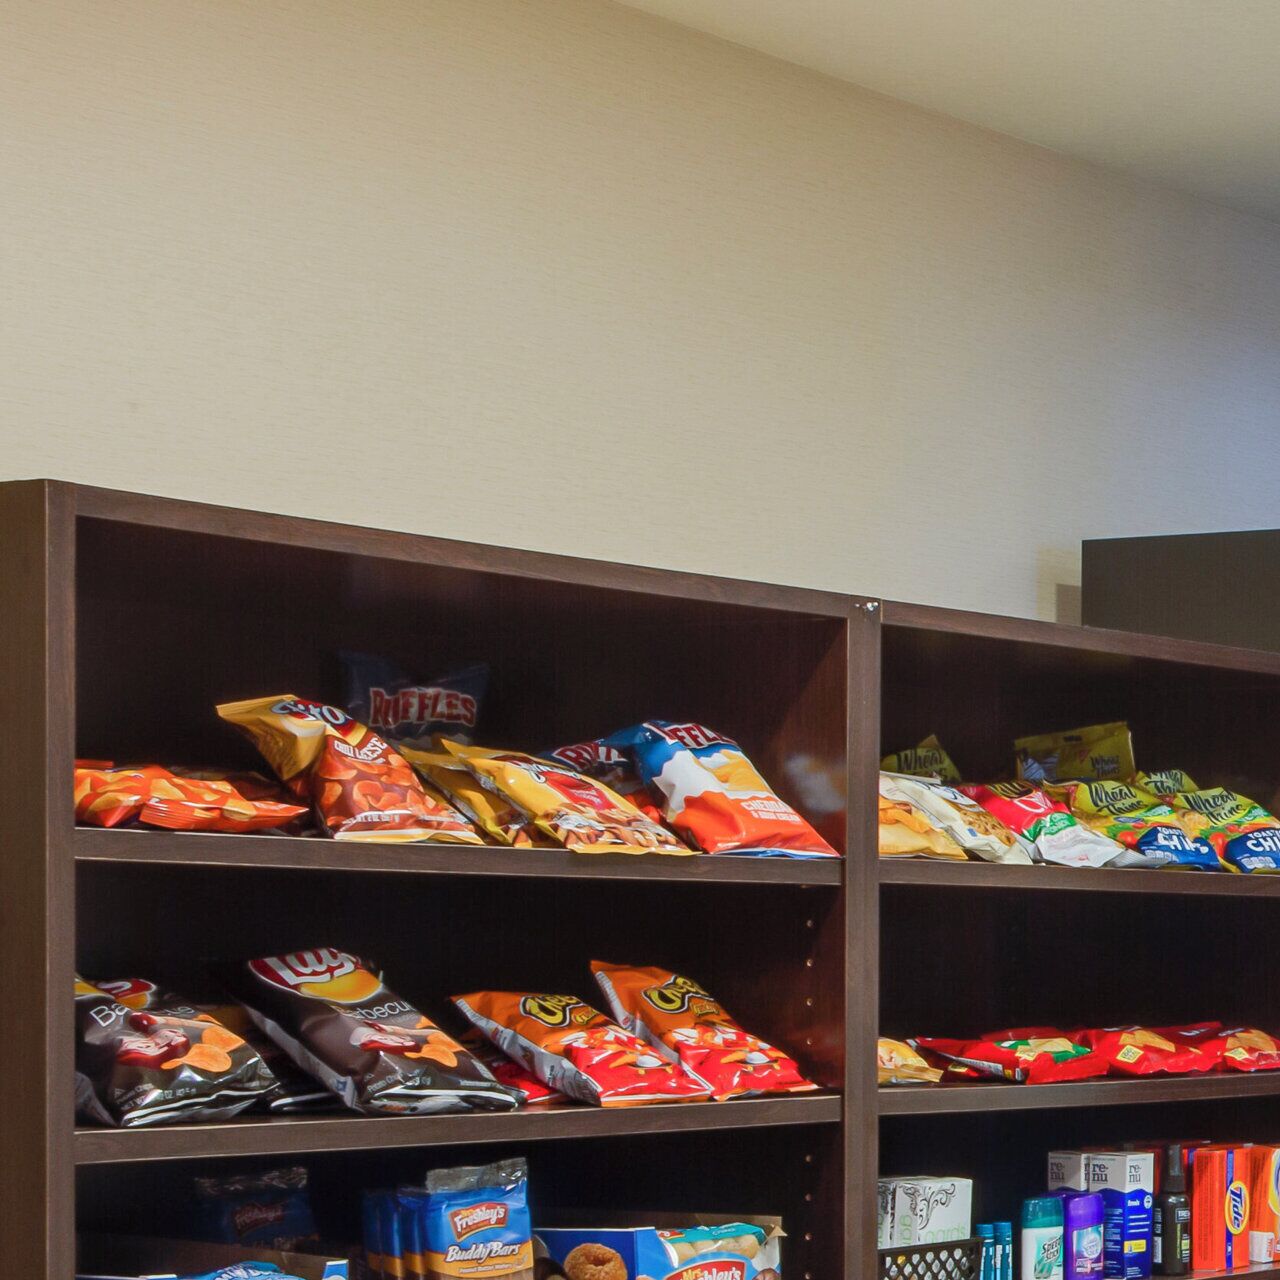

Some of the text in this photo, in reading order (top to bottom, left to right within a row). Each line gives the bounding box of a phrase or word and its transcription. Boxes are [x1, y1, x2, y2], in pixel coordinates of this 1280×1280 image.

[369, 687, 477, 729] RUFFLES
[1088, 784, 1137, 808] Wheat
[1182, 790, 1238, 813] Wheat
[1157, 827, 1184, 836] TOAST
[349, 997, 412, 1021] rbecu
[1092, 1173, 1108, 1182] nu
[454, 1207, 506, 1232] Freshley's
[1230, 1186, 1244, 1229] Tide
[445, 1241, 521, 1263] Buddy Bars
